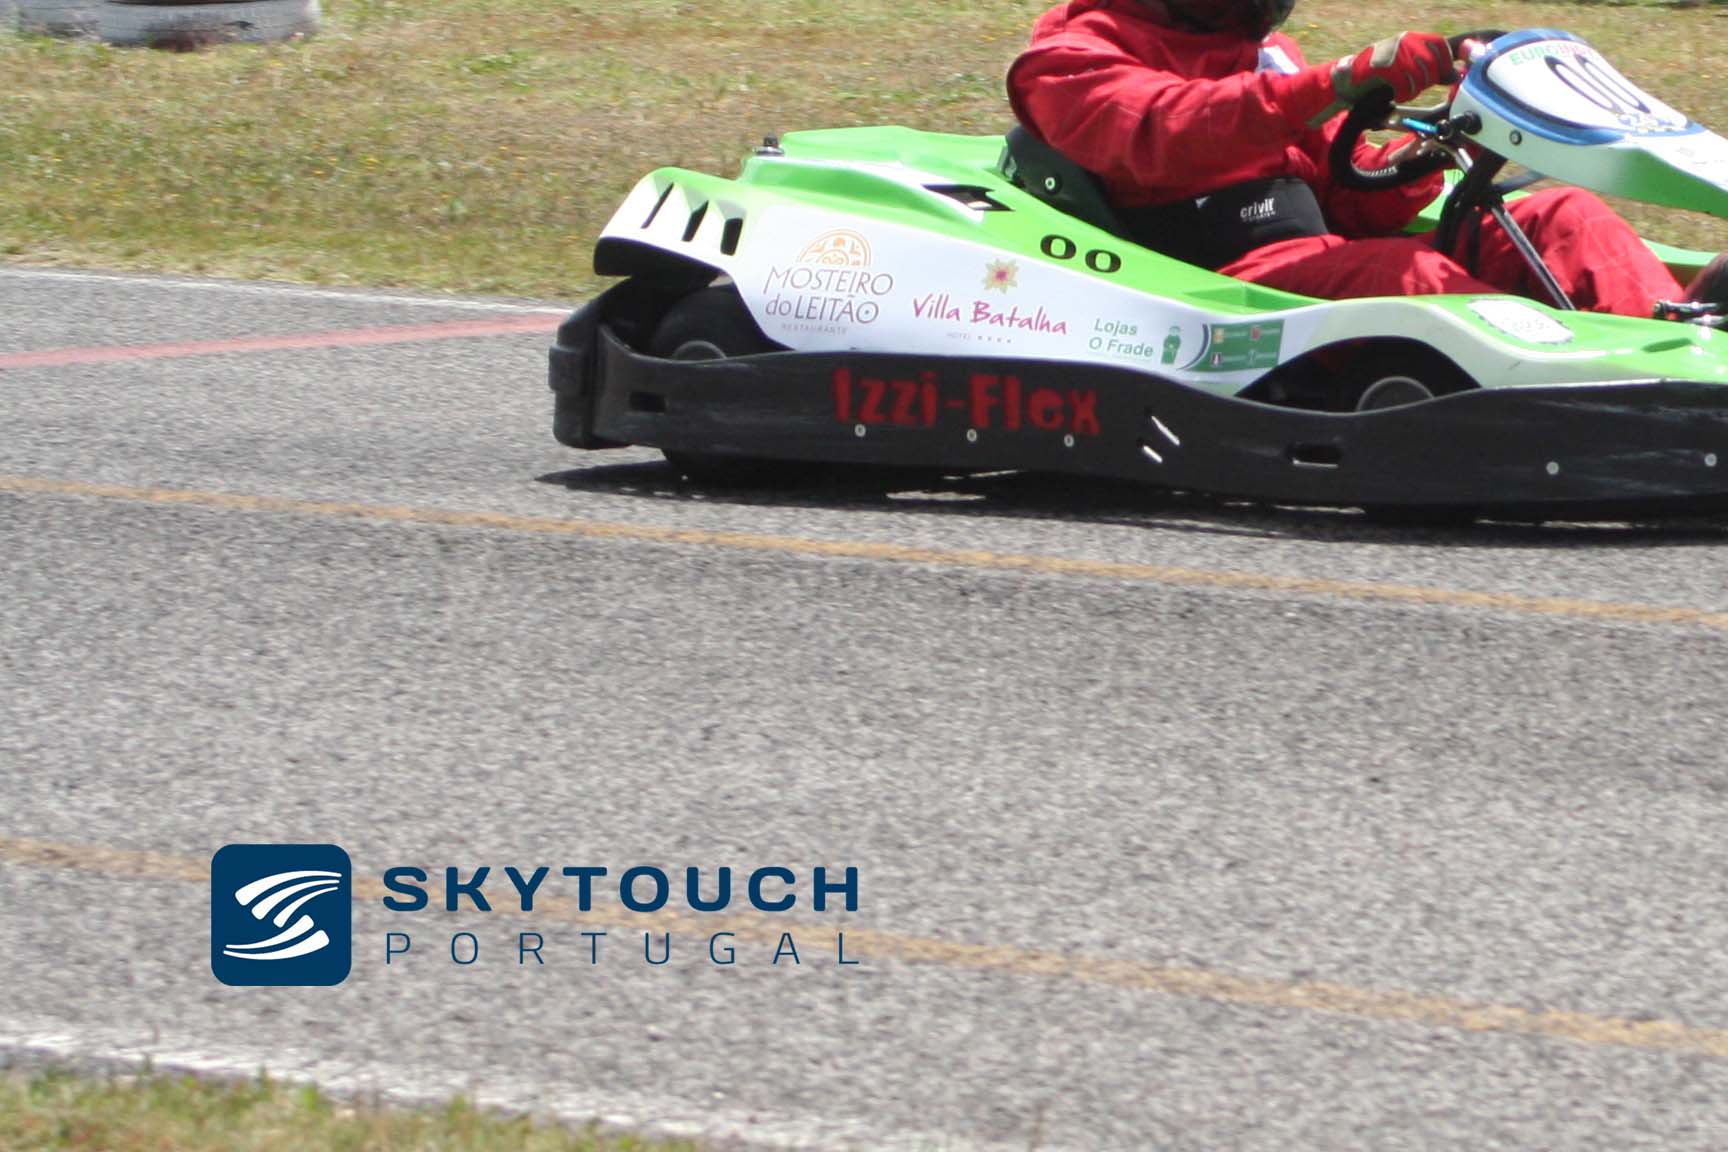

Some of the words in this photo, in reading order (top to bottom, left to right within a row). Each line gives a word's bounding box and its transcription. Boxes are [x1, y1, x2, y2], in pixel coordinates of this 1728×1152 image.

[763, 266, 894, 296] MOSTEIRO
[913, 293, 961, 321] Villa
[970, 300, 1068, 335] Batalha
[1094, 318, 1138, 336] Lojas
[1089, 336, 1104, 351] O
[1106, 338, 1154, 358] Frade
